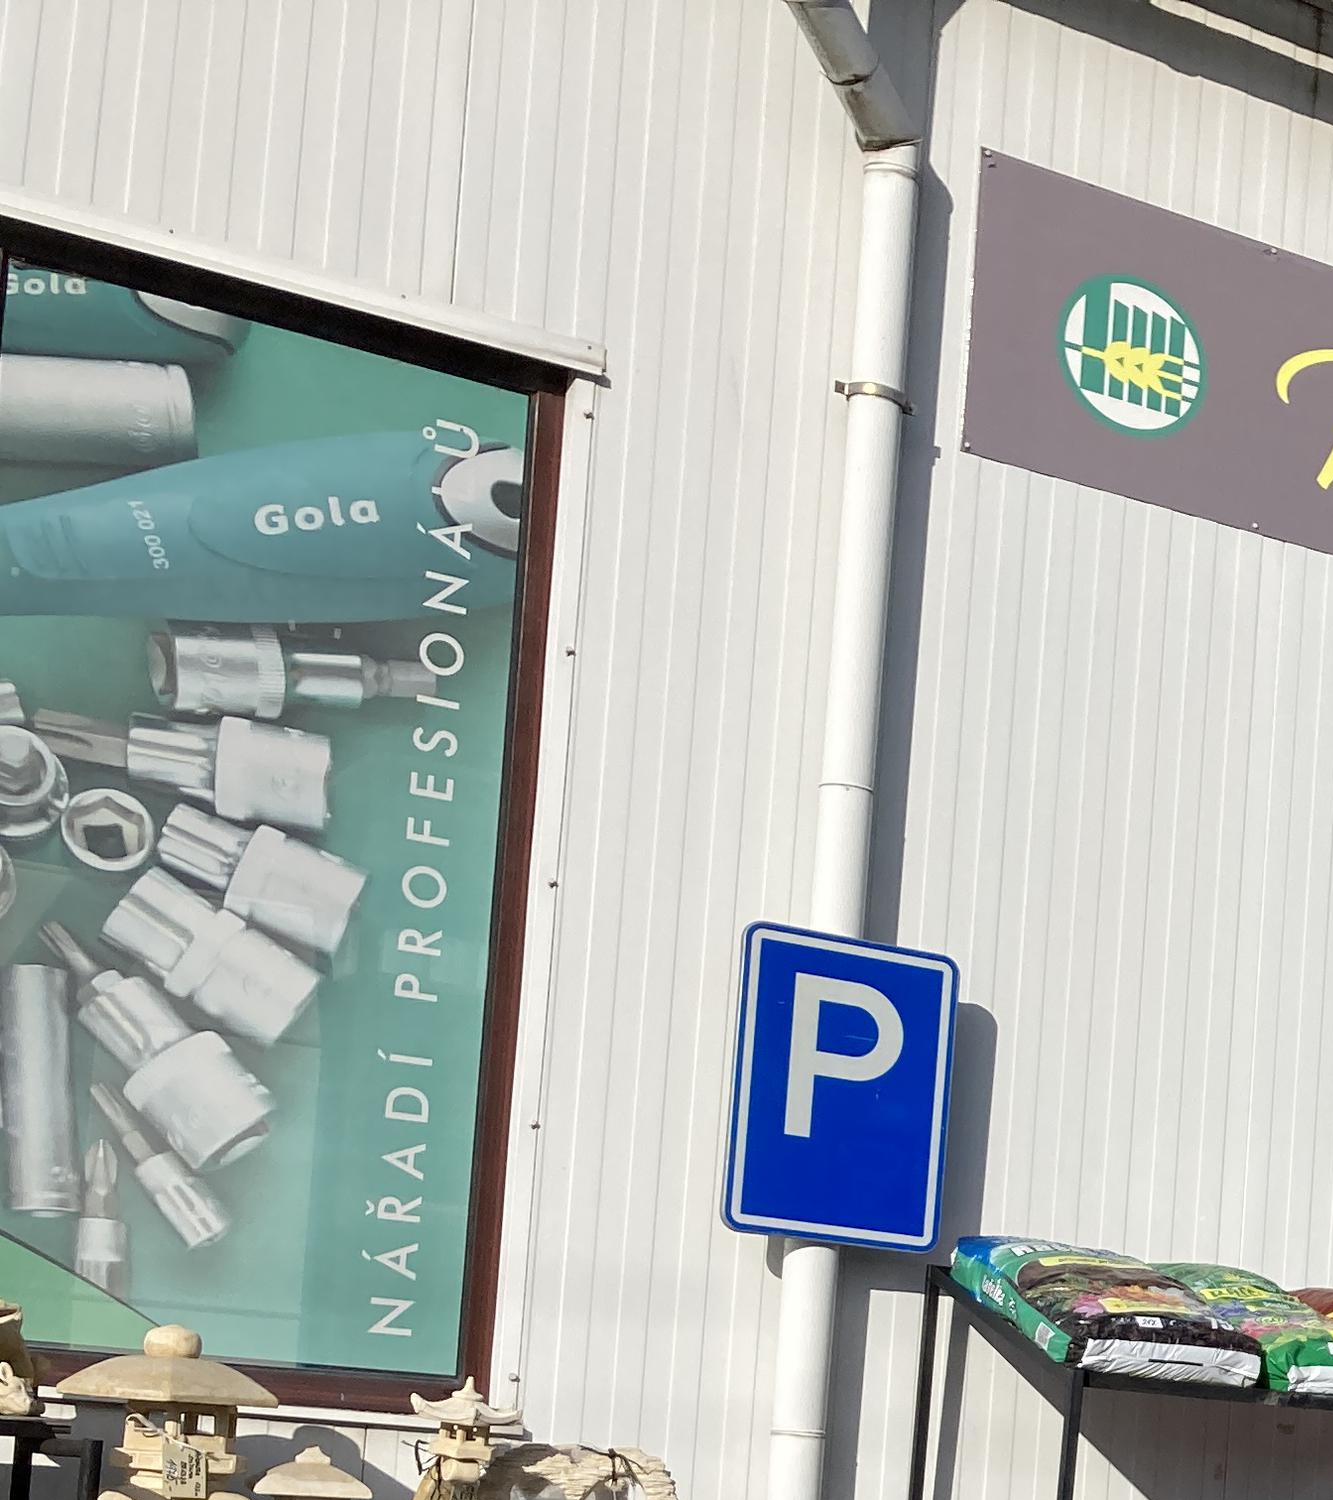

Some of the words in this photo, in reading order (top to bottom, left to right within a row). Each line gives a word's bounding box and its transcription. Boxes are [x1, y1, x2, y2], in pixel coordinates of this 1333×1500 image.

[143, 533, 170, 571] 300
[252, 495, 381, 536] Gola
[390, 418, 480, 1005] PROFESIONÁŮ
[783, 971, 905, 1139] P
[361, 1045, 436, 1339] NÁŘADÍ
